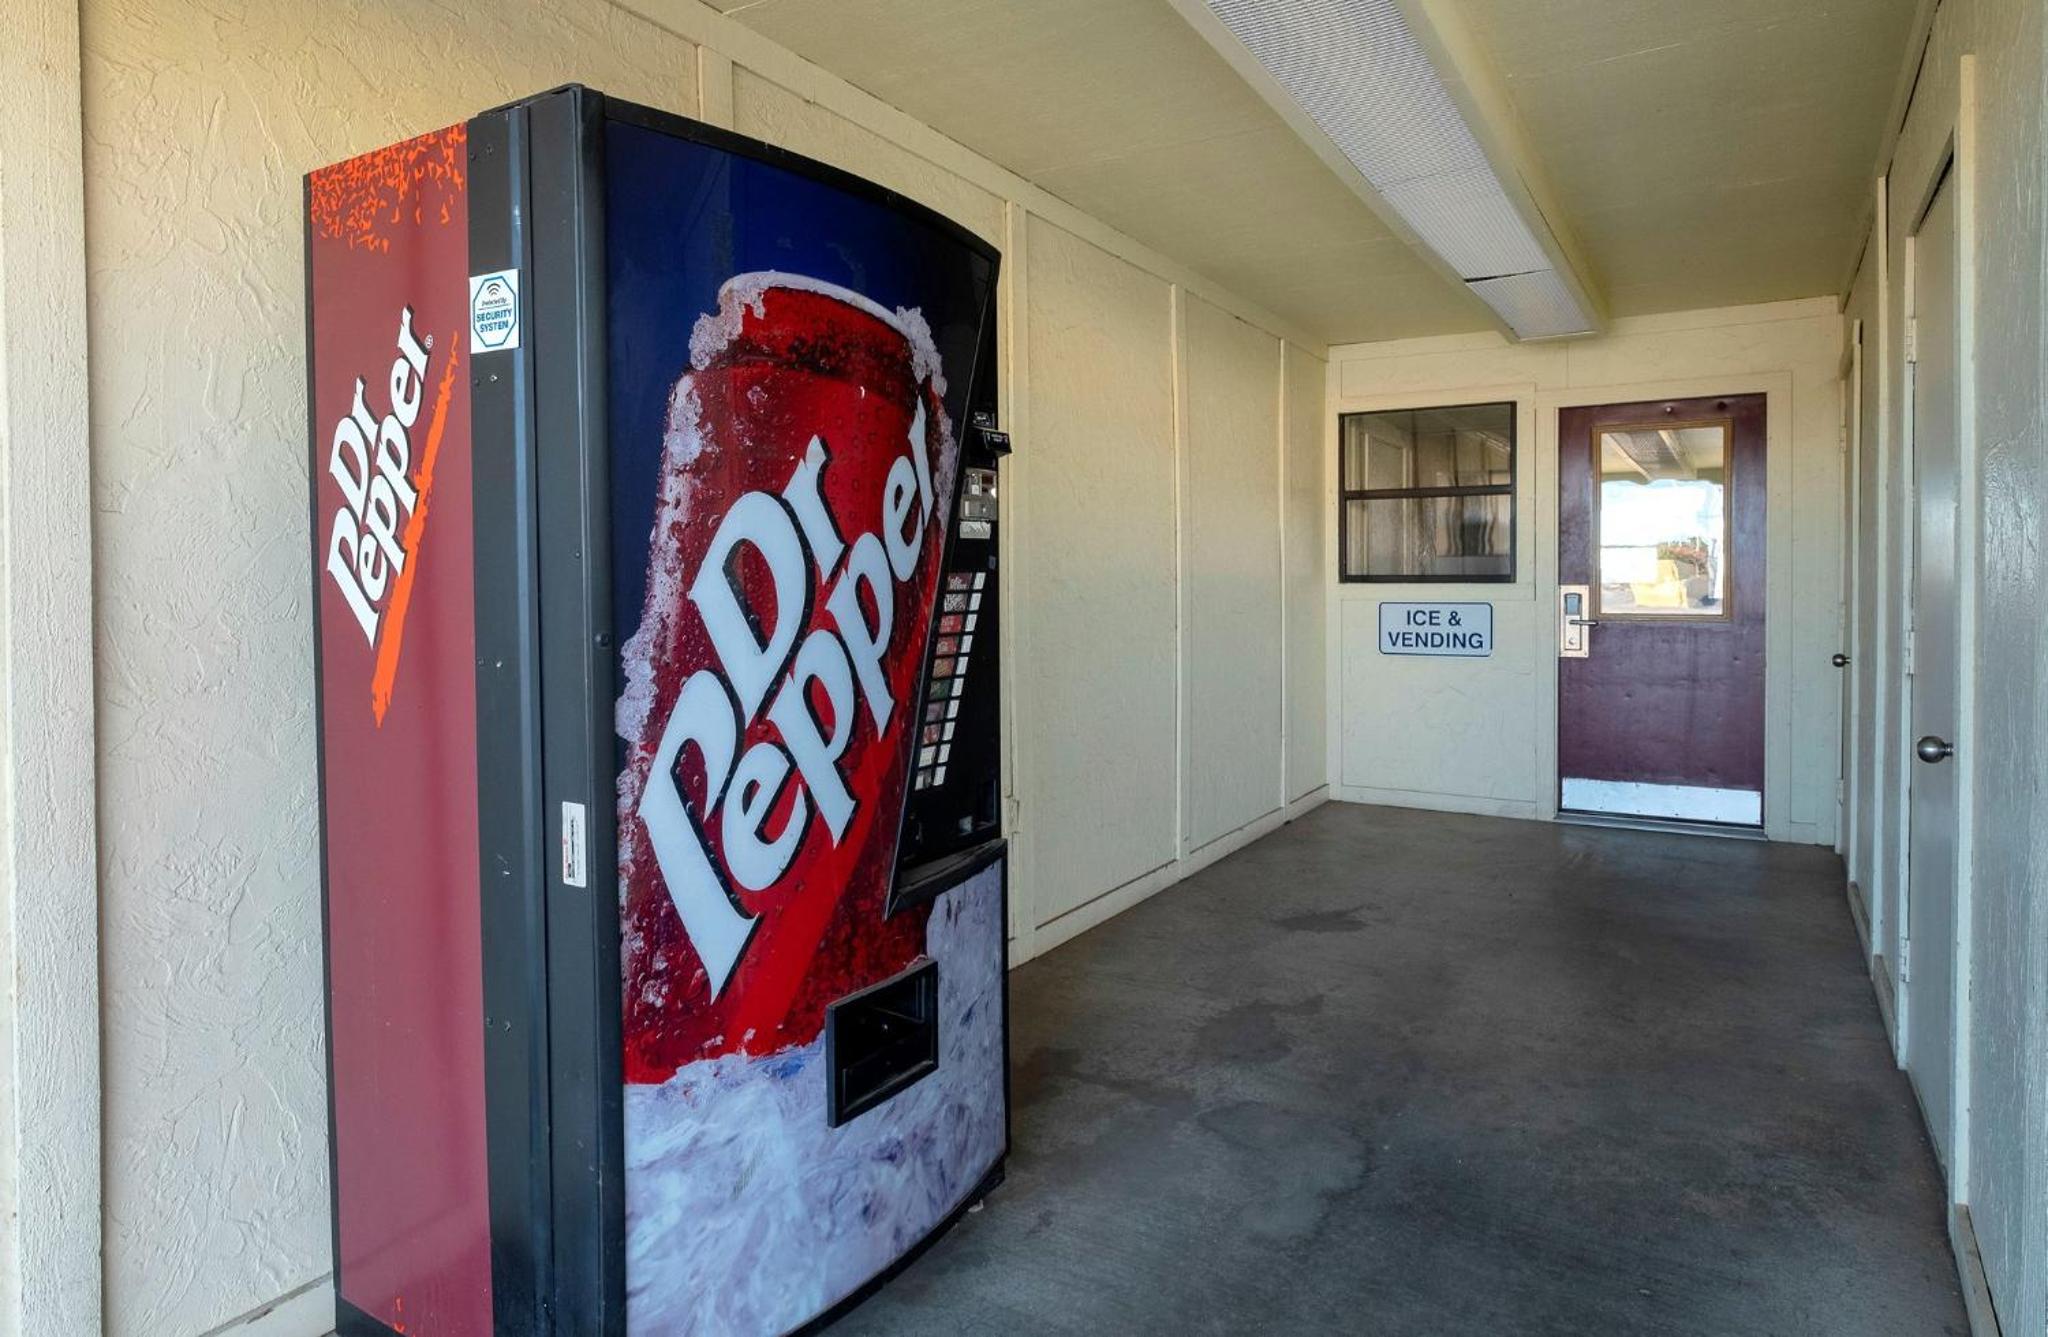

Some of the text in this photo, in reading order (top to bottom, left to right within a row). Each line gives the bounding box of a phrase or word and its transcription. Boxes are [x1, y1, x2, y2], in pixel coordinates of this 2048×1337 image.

[476, 309, 512, 323] SECURITY
[480, 319, 509, 332] SYSTEM
[327, 305, 430, 650] Pepper
[329, 375, 379, 519] Dr
[688, 434, 845, 729] Dr
[1407, 610, 1462, 626] ICE &
[1388, 631, 1484, 649] VENDING
[638, 397, 935, 1005] Pepper
